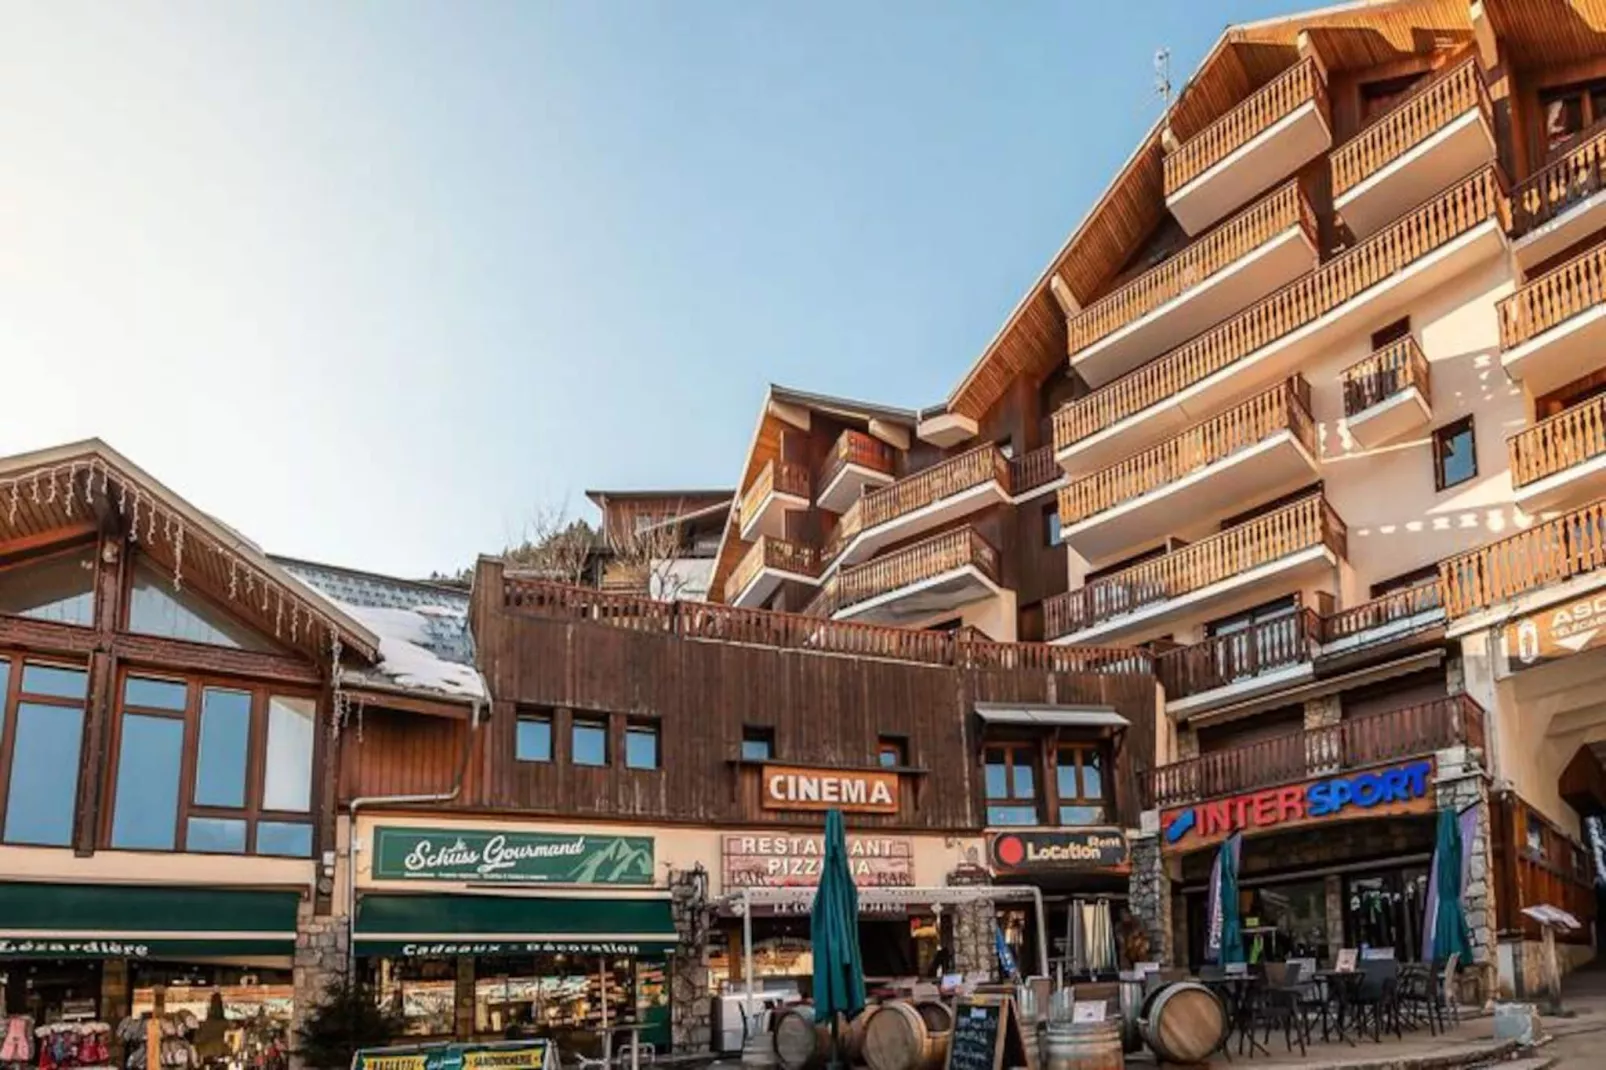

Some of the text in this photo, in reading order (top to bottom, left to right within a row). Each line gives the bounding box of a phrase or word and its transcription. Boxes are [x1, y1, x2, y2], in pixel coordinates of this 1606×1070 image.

[769, 775, 893, 804] CINEMA
[1194, 761, 1431, 836] INTERSPORT
[741, 837, 893, 856] RESTAANT
[1088, 835, 1121, 848] Rent
[477, 835, 585, 873] Gourmand
[1027, 842, 1101, 860] Location
[767, 858, 871, 876] PIZZIA
[403, 944, 500, 956] Cadeaux
